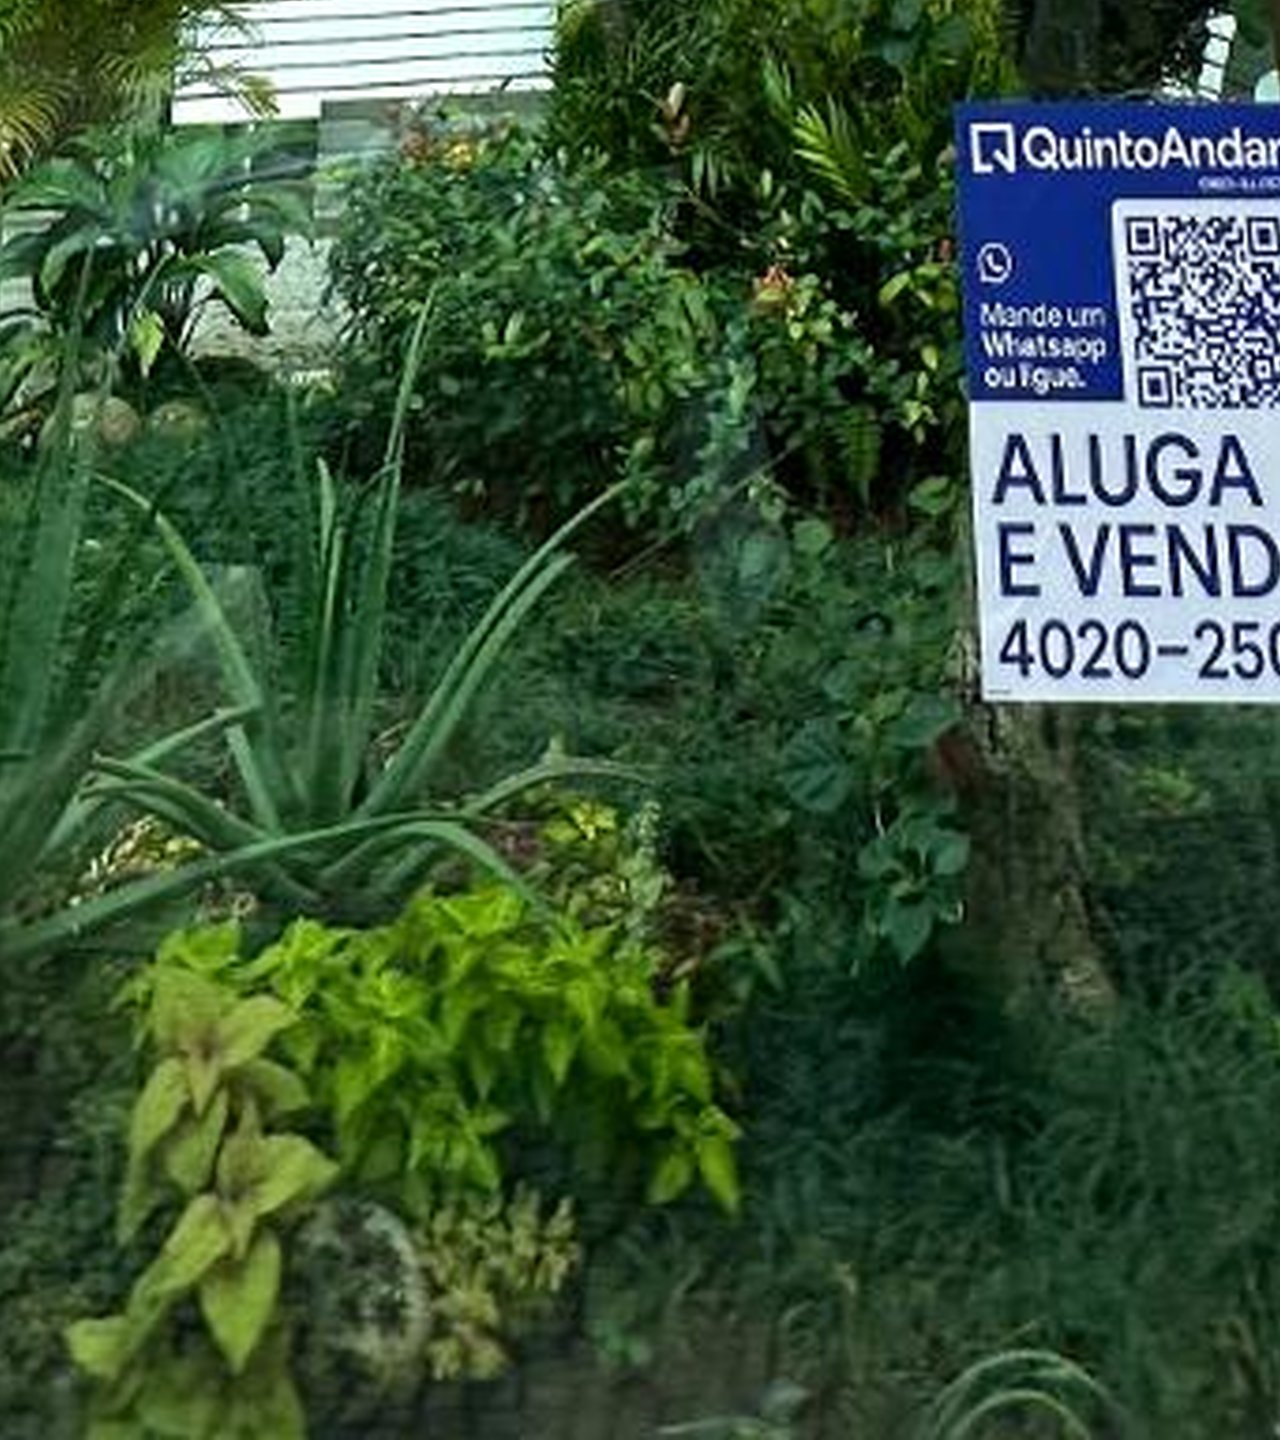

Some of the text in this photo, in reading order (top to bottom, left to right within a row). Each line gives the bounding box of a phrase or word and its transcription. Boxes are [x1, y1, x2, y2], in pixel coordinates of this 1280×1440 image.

[980, 302, 1106, 328] Mande um
[980, 330, 1107, 365] Whatsapp
[984, 366, 1016, 388] ou
[990, 431, 1264, 508] ALUGA
[997, 521, 1042, 599] E
